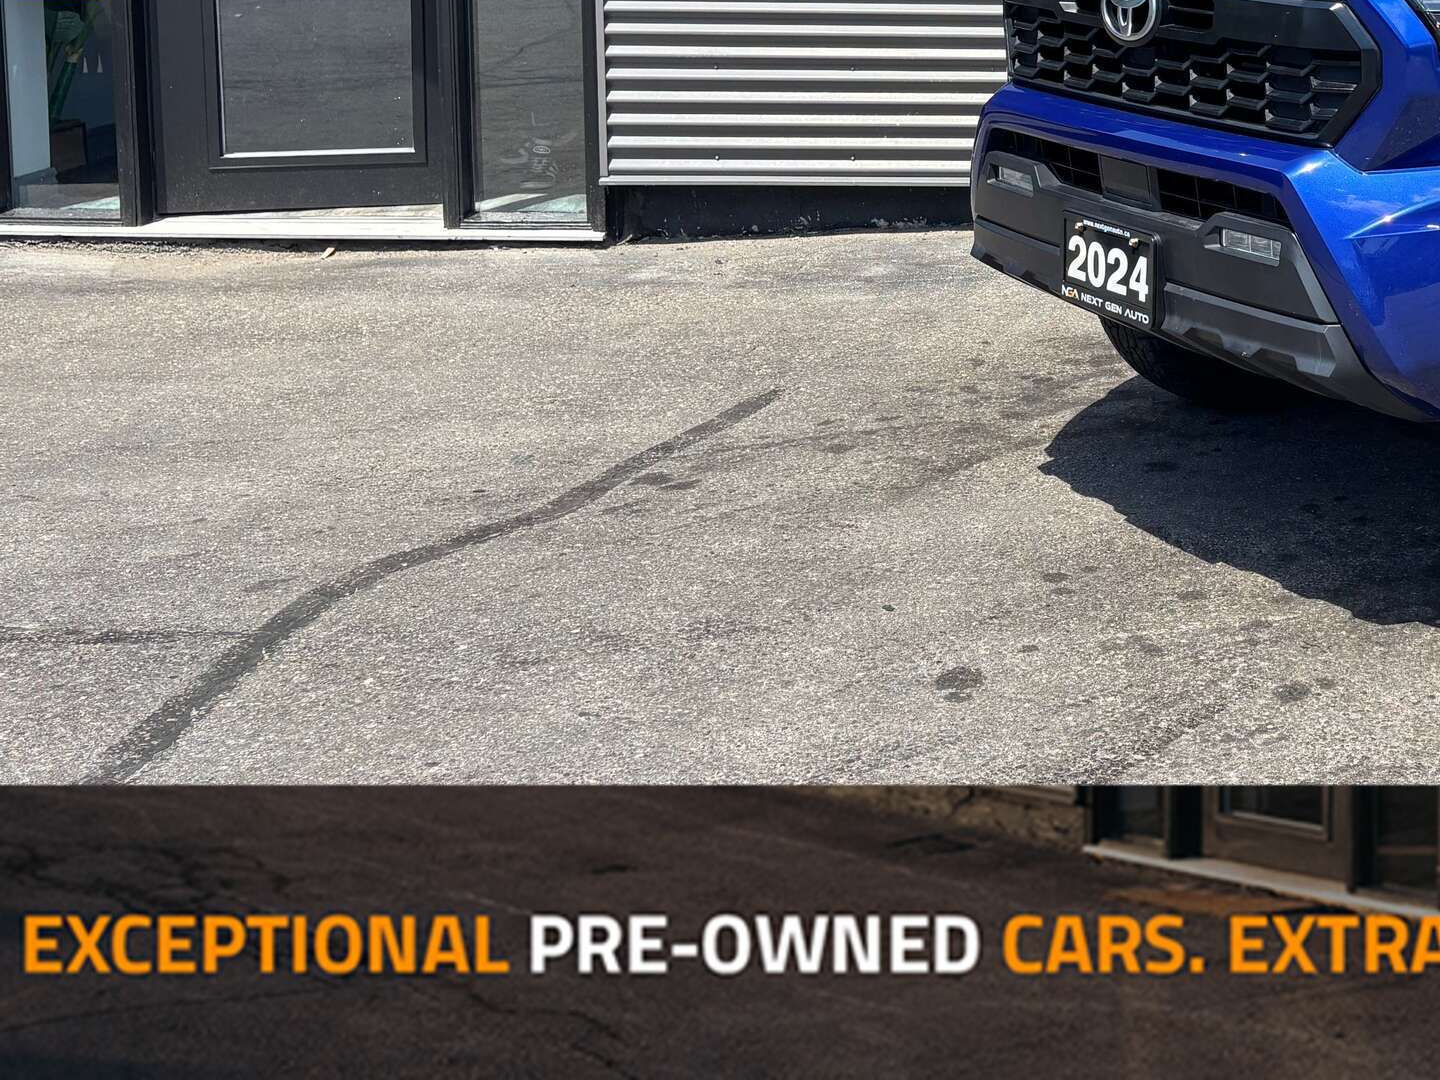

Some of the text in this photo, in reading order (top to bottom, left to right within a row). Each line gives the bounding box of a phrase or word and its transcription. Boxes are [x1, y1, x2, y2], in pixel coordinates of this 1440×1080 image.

[1067, 234, 1149, 303] 2024
[1061, 284, 1150, 324] NGA NEXT GEN AUTO
